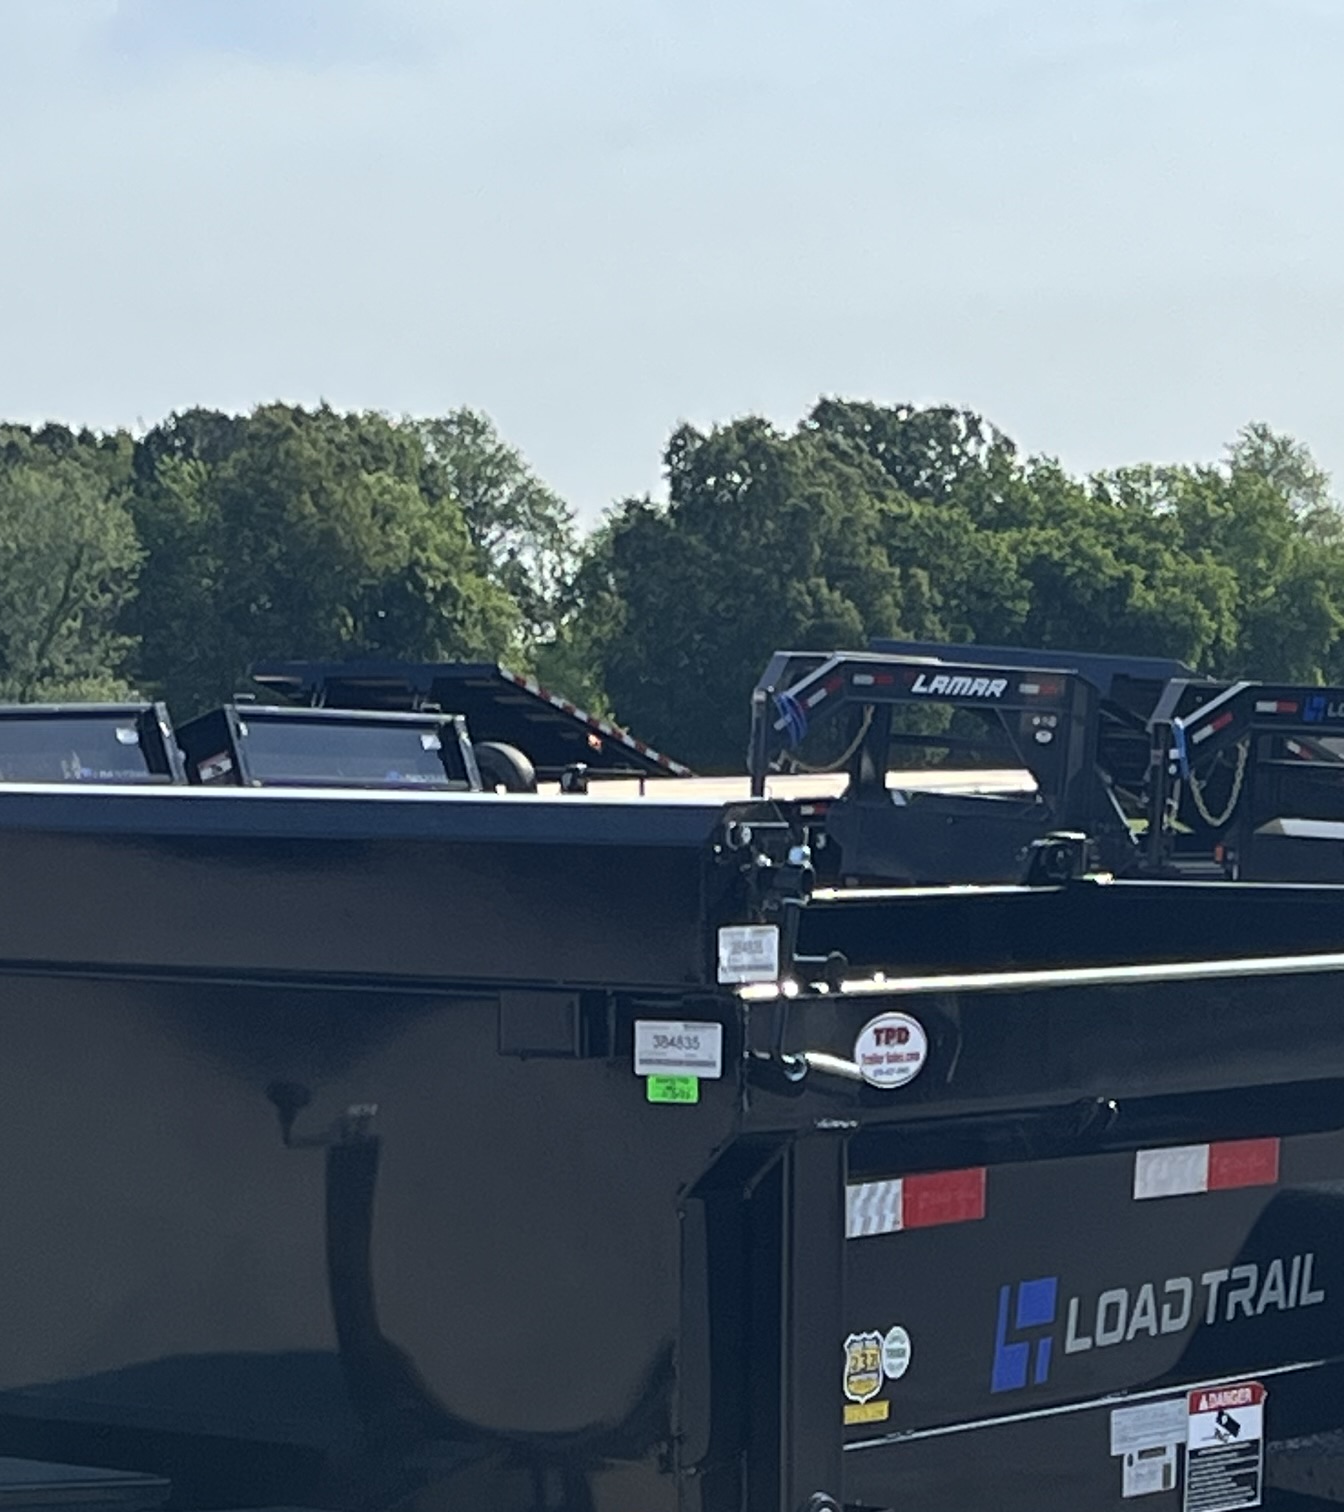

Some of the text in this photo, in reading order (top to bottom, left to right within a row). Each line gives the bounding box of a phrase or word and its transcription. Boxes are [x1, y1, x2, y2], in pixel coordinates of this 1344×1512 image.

[910, 673, 1008, 698] LAMAR
[873, 1026, 910, 1047] TPD
[1064, 1252, 1326, 1355] LOAD TRAIL
[1208, 1387, 1253, 1409] DANGER
